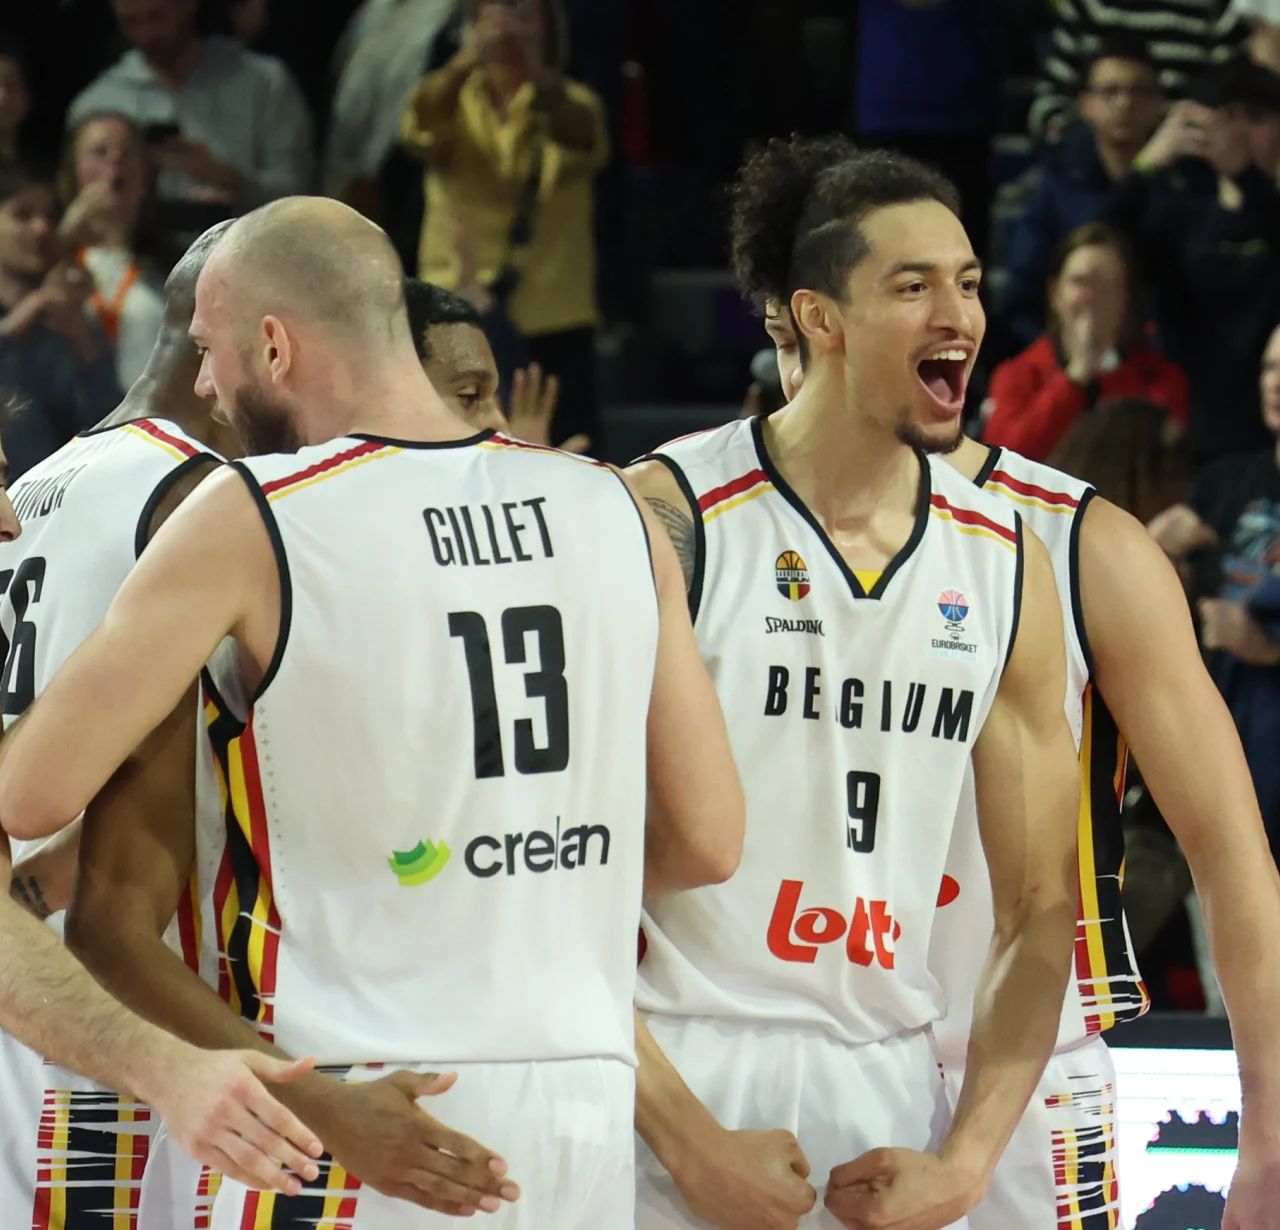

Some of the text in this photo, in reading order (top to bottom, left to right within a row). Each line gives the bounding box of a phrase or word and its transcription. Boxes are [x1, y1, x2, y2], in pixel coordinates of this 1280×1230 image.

[422, 496, 554, 566] GILLET
[446, 603, 570, 780] 13
[764, 665, 974, 743] BEGIUM
[463, 815, 611, 879] crelan
[846, 769, 881, 854] 9
